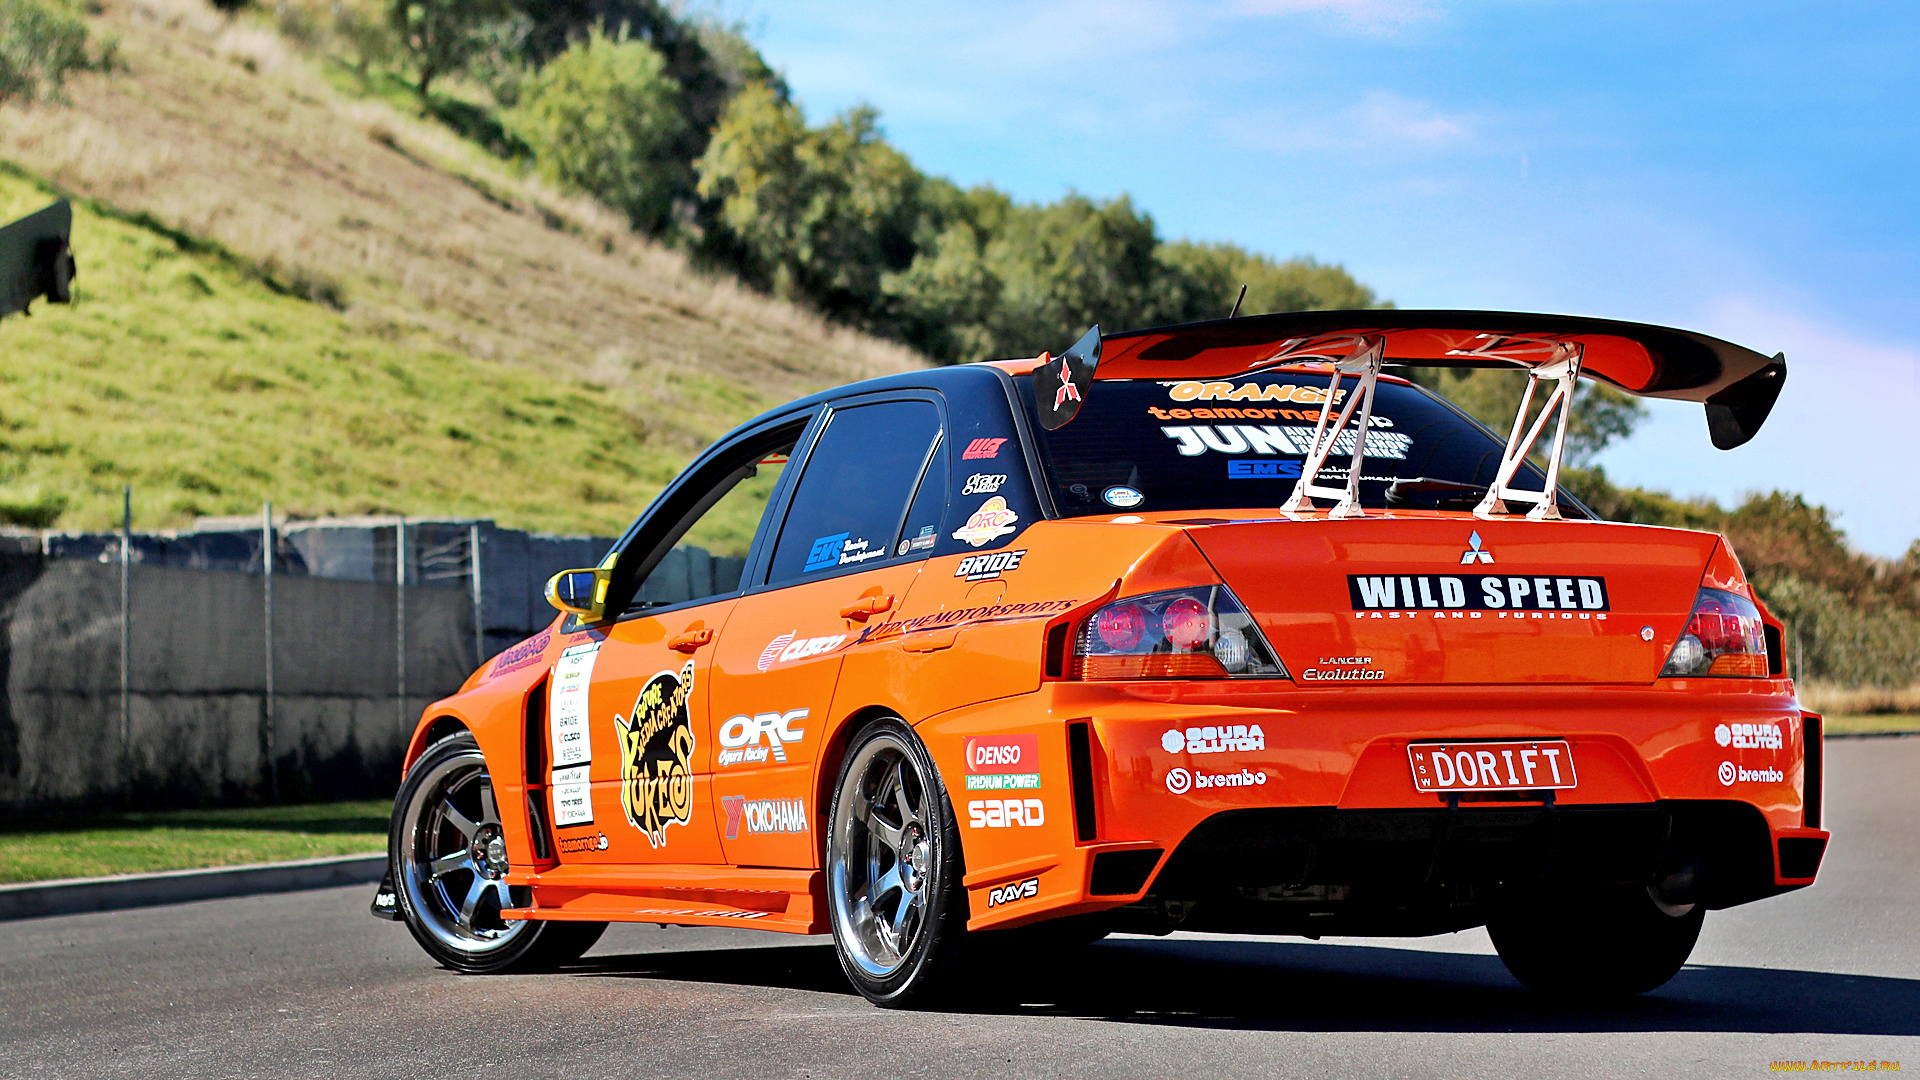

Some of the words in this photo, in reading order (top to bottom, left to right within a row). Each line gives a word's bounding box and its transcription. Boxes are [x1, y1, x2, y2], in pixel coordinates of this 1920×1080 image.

[1169, 381, 1346, 405] ORANGE
[1160, 425, 1302, 456] JUN
[1228, 460, 1302, 479] EMS
[803, 532, 850, 573] EMS
[954, 550, 1027, 577] BRIDE
[1356, 577, 1466, 608] WILD
[1480, 577, 1604, 609] SPEED
[1355, 611, 1418, 619] FAST
[1433, 611, 1483, 619] AND
[1498, 611, 1608, 620] FURIOUS
[779, 634, 847, 662] CUSCO
[1302, 668, 1385, 680] Evolution
[635, 682, 663, 728] FUTURE
[719, 708, 810, 762] ORC
[1185, 724, 1265, 740] OGURA
[1732, 736, 1783, 749] CLUTCH
[718, 749, 744, 767] Ogura
[743, 746, 769, 763] Racing
[975, 745, 1021, 765] DENSO
[1186, 737, 1265, 754] CLUTCH
[1195, 768, 1267, 788] brembo
[1431, 748, 1560, 786] DORIFT
[1738, 765, 1784, 783] brembo
[967, 775, 1004, 790] IRIDIUM
[1003, 774, 1039, 788] POWER
[743, 797, 809, 834] YOKOHAMA
[988, 878, 1038, 908] RAYS
